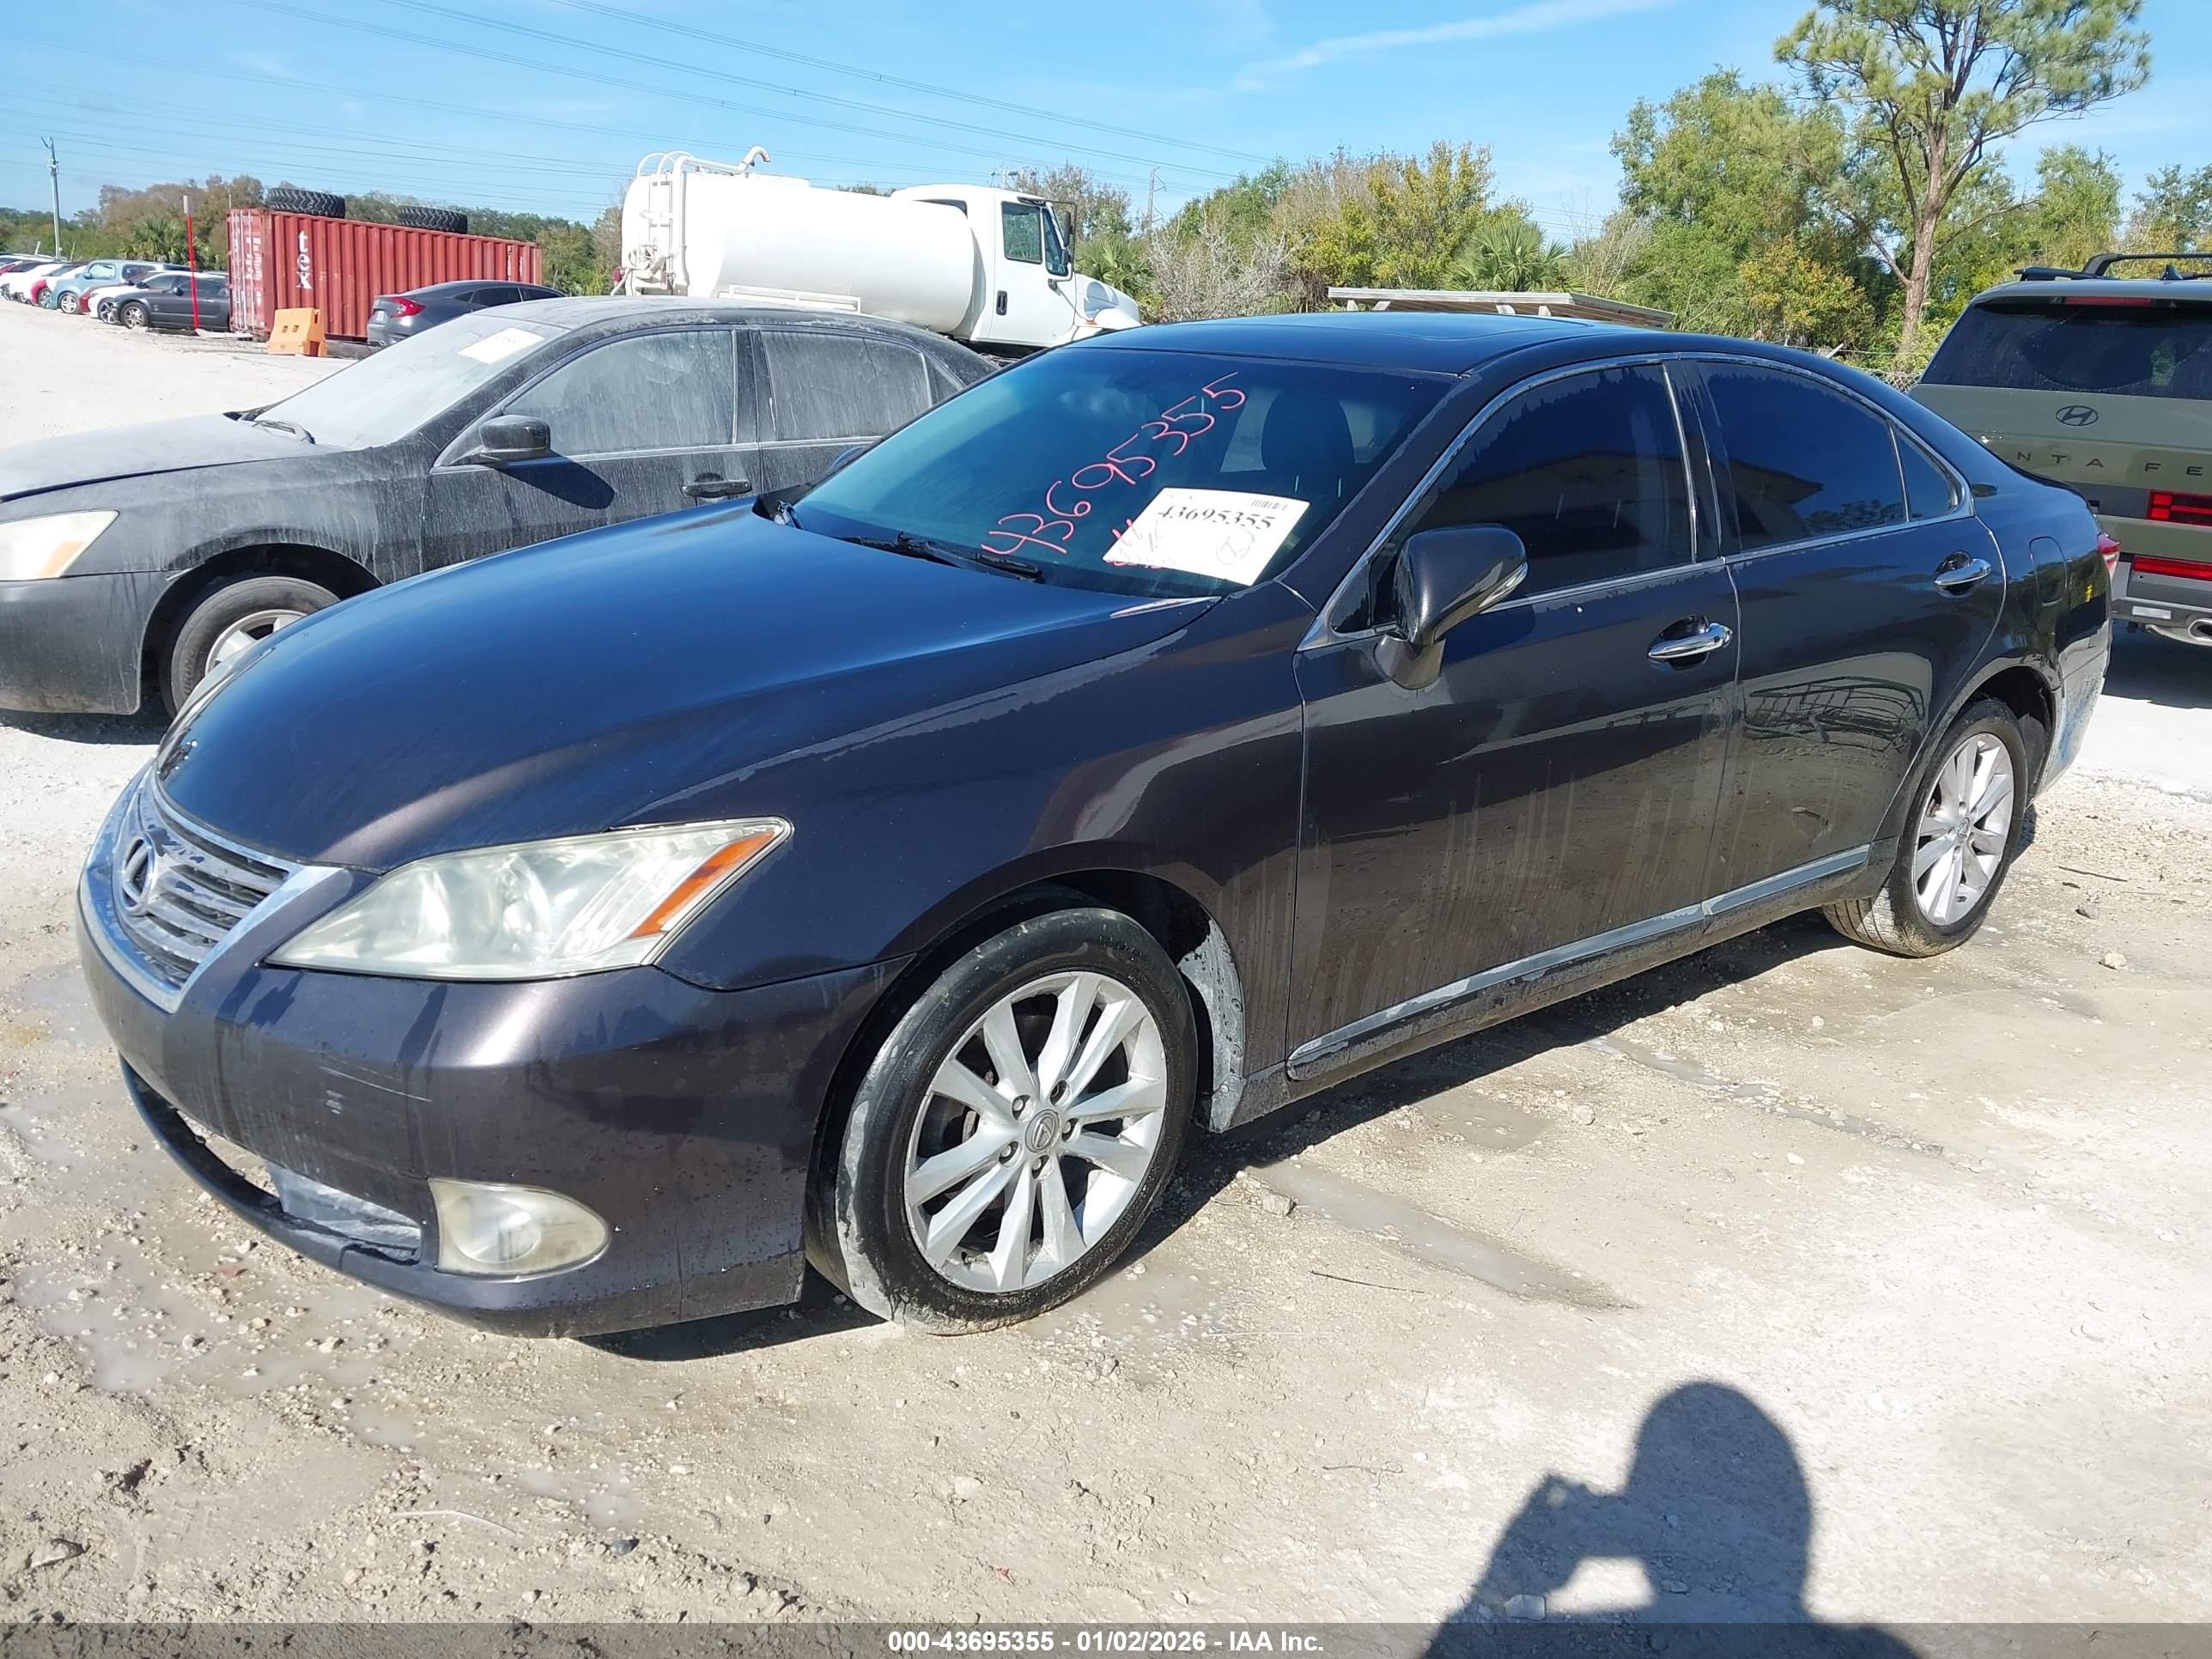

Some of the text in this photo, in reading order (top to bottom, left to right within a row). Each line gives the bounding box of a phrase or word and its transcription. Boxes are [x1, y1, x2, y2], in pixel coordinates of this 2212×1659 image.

[296, 229, 313, 289] tex
[981, 371, 1247, 556] 43695355
[2017, 451, 2204, 477] NTA FE
[1157, 504, 1278, 531] 43695355
